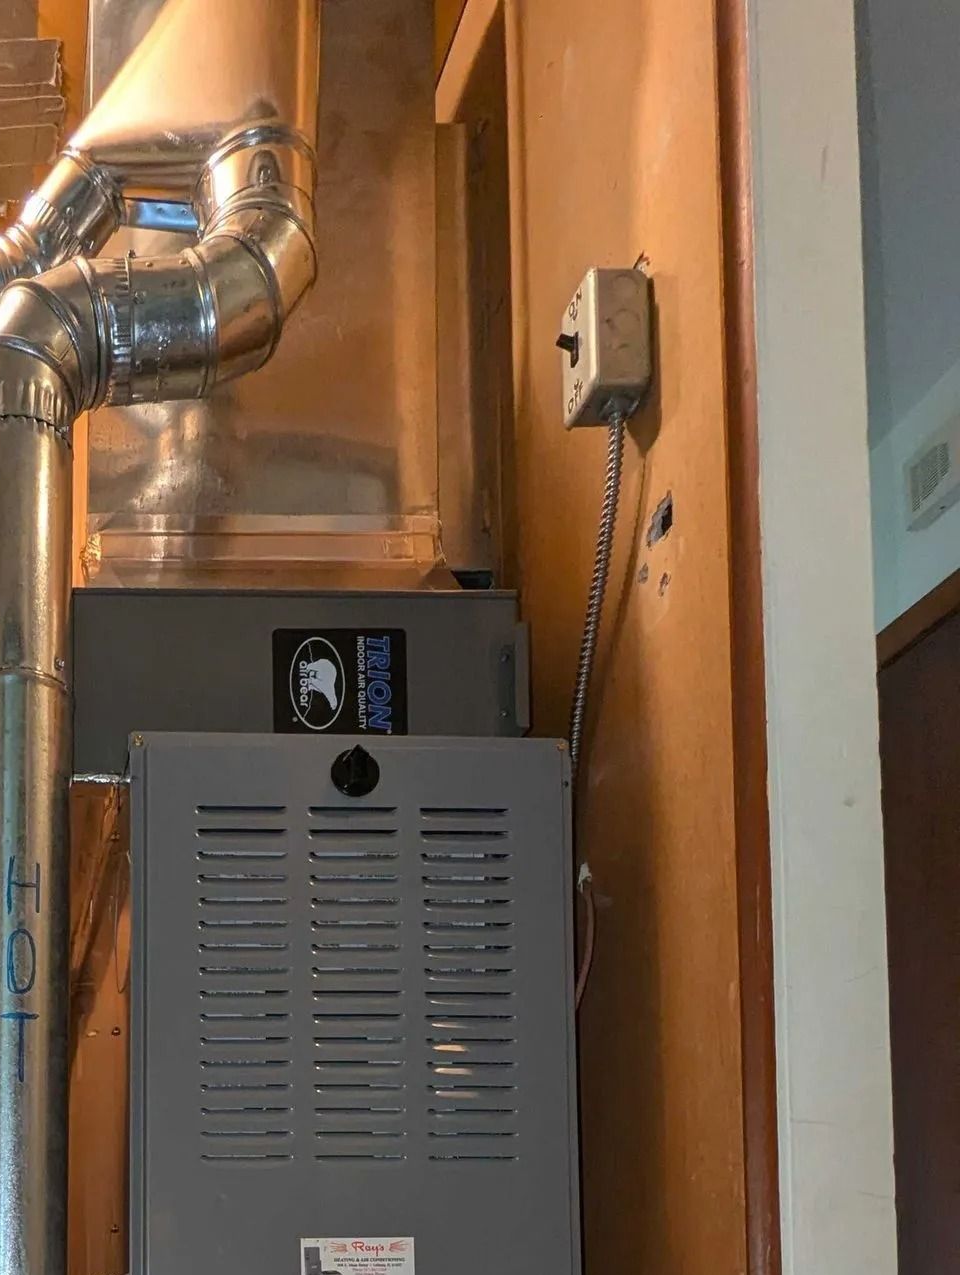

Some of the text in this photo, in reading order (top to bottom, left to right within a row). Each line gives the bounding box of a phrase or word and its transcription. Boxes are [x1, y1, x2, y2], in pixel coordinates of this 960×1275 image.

[568, 288, 582, 320] ON
[357, 636, 367, 730] INDOOR AIR QUALITY
[367, 636, 392, 731] TRION
[0, 855, 40, 1082] HOT
[351, 1241, 385, 1256] Ray's
